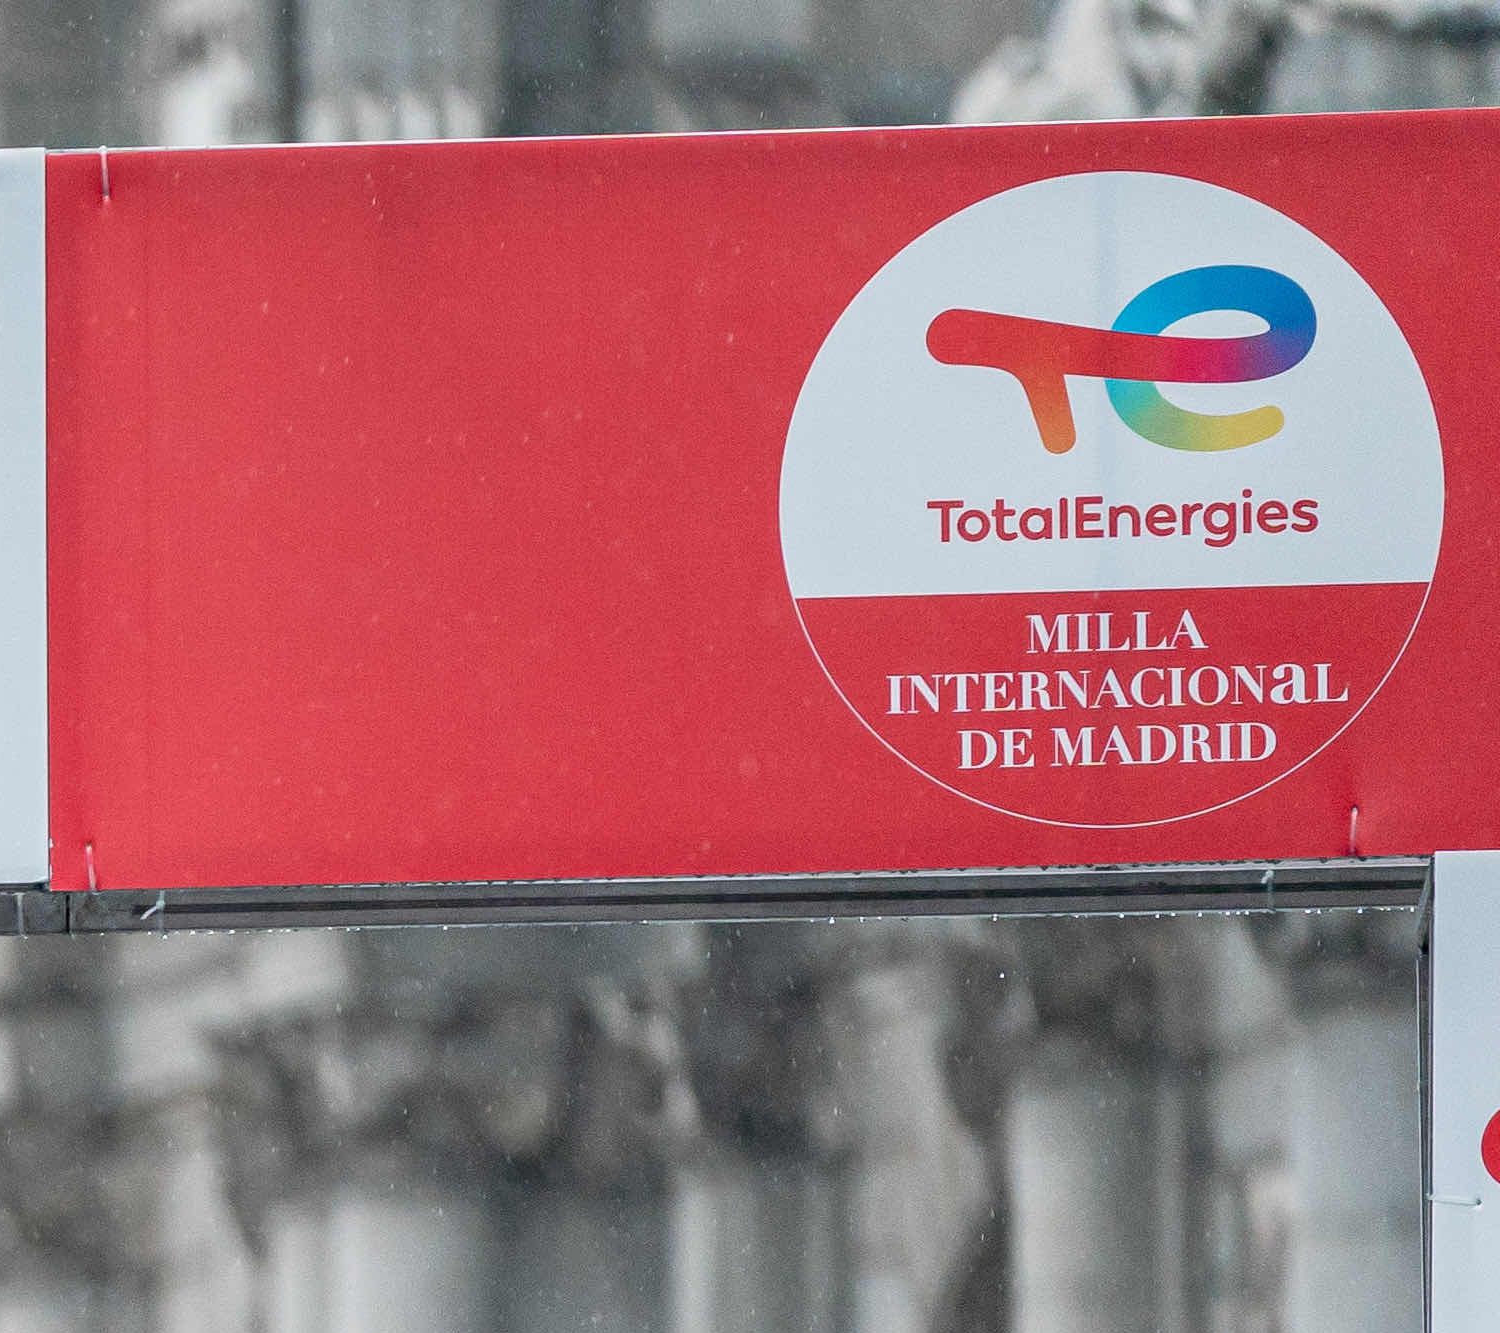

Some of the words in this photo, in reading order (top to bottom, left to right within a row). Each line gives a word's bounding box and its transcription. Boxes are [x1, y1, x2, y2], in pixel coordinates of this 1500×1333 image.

[927, 489, 1319, 548] TotalEnergies
[1025, 609, 1209, 654] MILLA
[957, 728, 1035, 770] DE
[1050, 722, 1277, 768] MADRID
